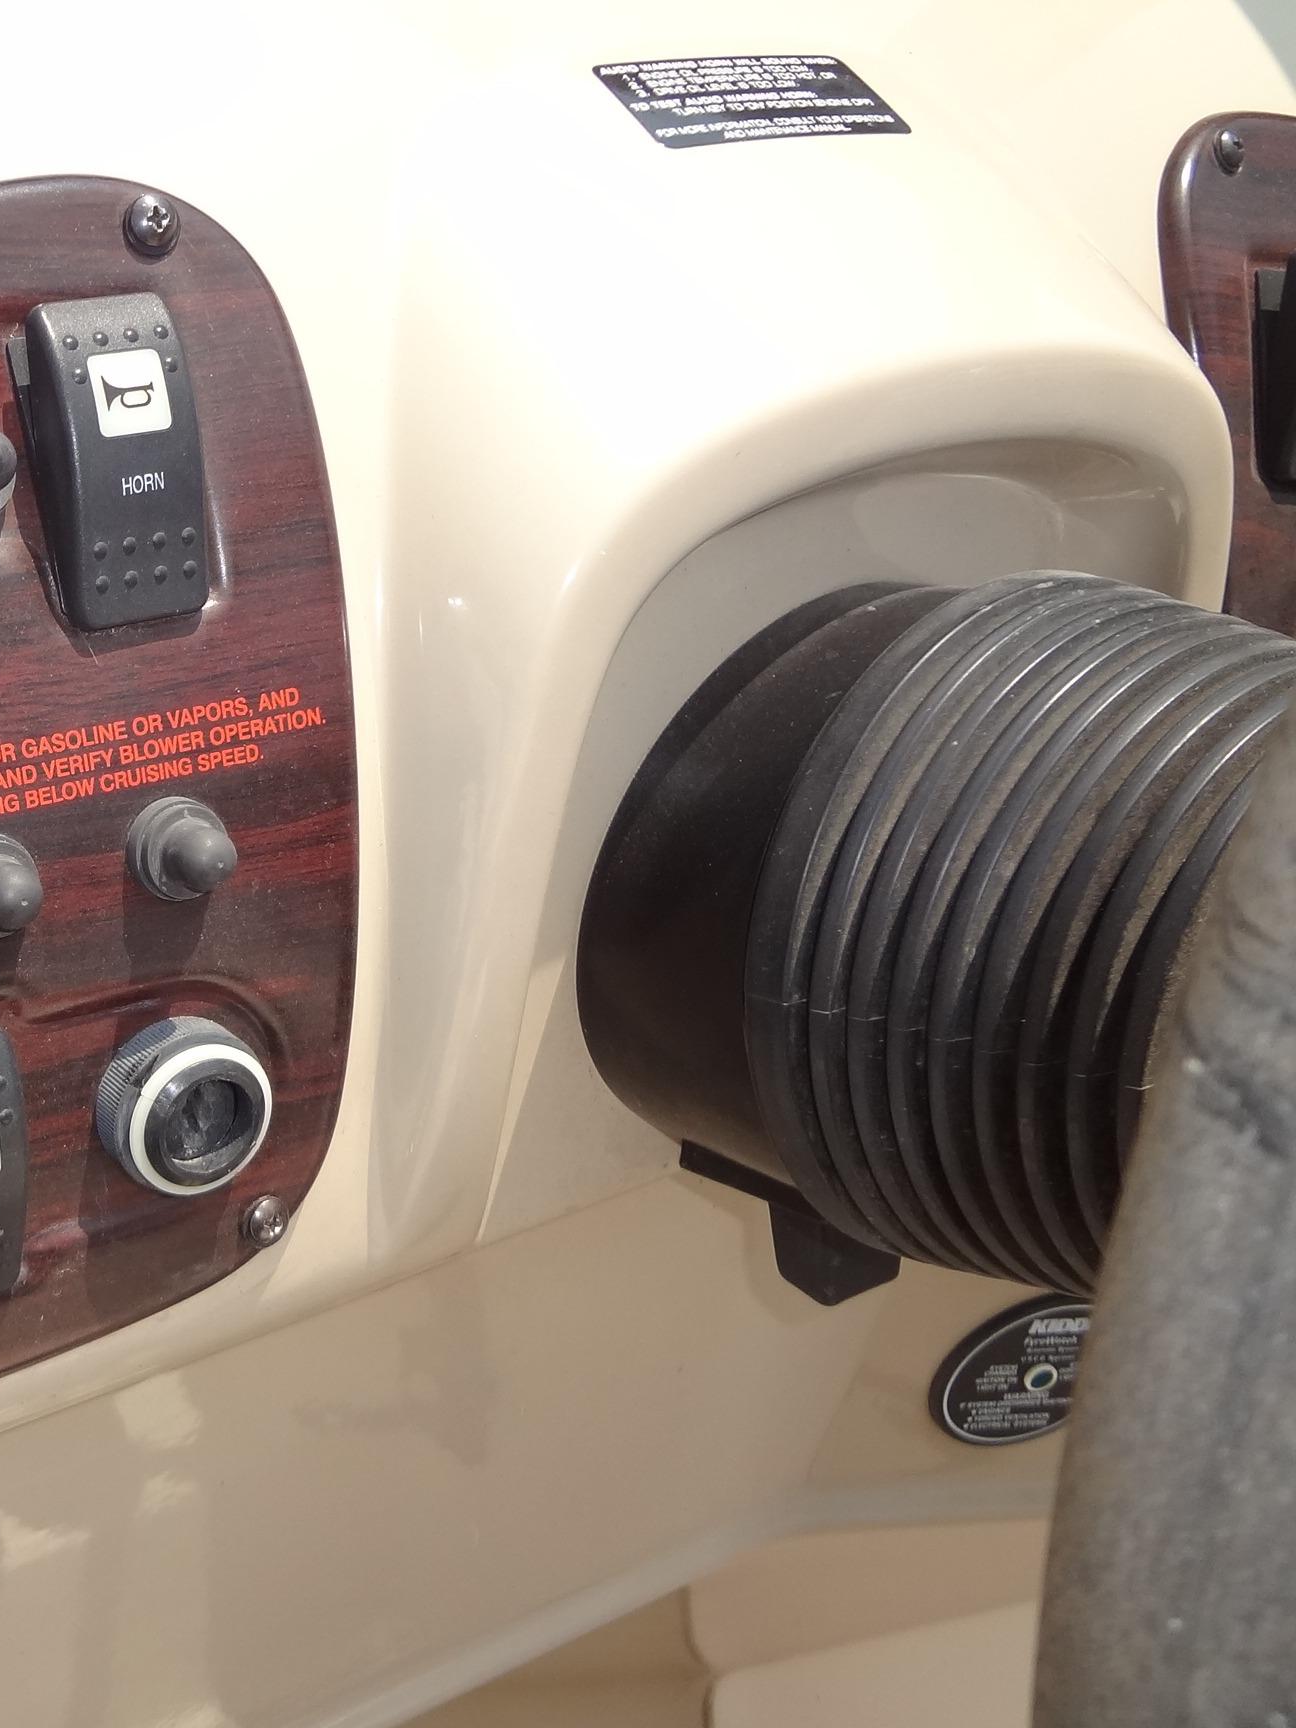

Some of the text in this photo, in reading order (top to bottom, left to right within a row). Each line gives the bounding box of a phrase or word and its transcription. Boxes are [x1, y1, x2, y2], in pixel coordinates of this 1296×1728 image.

[600, 64, 639, 76] AUDIO
[639, 60, 697, 71] WARNING
[697, 59, 733, 67] HORN
[732, 58, 761, 66] WILL
[761, 57, 801, 66] SOUND
[638, 70, 680, 80] ENGINE
[697, 66, 752, 76] PRESSURE
[763, 65, 786, 73] TOO
[646, 77, 687, 88] ENGINE
[686, 73, 762, 84] TEMPERATURE
[773, 72, 796, 80] TOO
[704, 82, 738, 91] LEVEL
[749, 80, 773, 89] TOO
[650, 99, 682, 109] TEST
[684, 95, 724, 106] AUDIO
[723, 92, 780, 103] WARNING
[773, 116, 816, 126] CONSULT
[121, 471, 165, 497] HORN
[21, 721, 127, 758] GASOLINE
[132, 713, 165, 737] OR
[167, 696, 253, 729] VAPORS,
[259, 687, 299, 712] AND
[41, 750, 114, 782] VERIFY
[119, 732, 205, 765] BLOWER
[209, 706, 327, 746] OPERATION.
[24, 776, 95, 809] BELOW
[99, 755, 194, 792] CRUISING
[197, 742, 265, 773] SPEED.
[1028, 1318, 1088, 1335] KIDD
